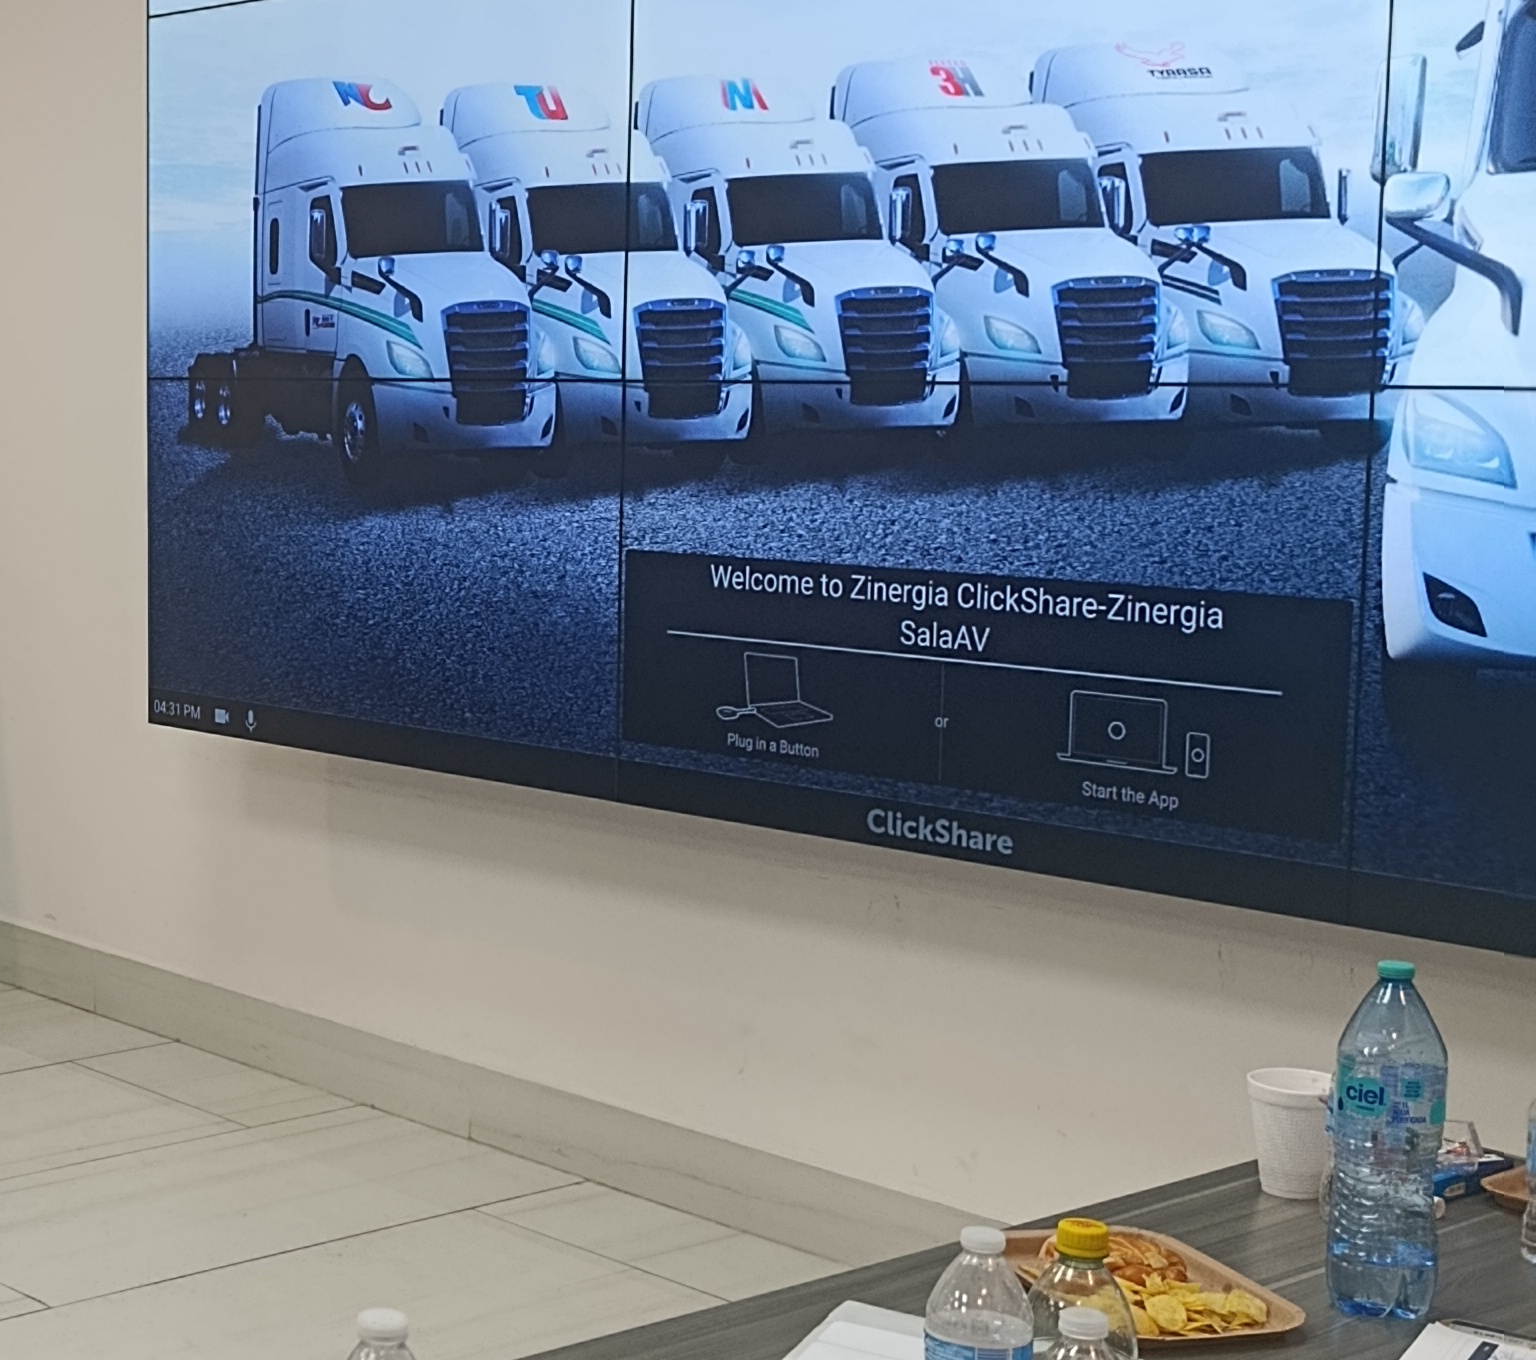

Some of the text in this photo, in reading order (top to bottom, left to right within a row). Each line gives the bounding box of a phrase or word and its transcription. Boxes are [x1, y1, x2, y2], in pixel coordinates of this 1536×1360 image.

[710, 564, 1224, 634] Welcome to Zinergia ClickShare-Zinergia
[900, 620, 990, 652] SalaAV
[153, 699, 201, 720] 04:31 PM
[934, 716, 949, 728] or
[727, 732, 820, 758] Plug in a Button
[1082, 781, 1179, 811] Start the App
[867, 808, 1013, 855] ClickShare
[1345, 1082, 1385, 1107] ciel
